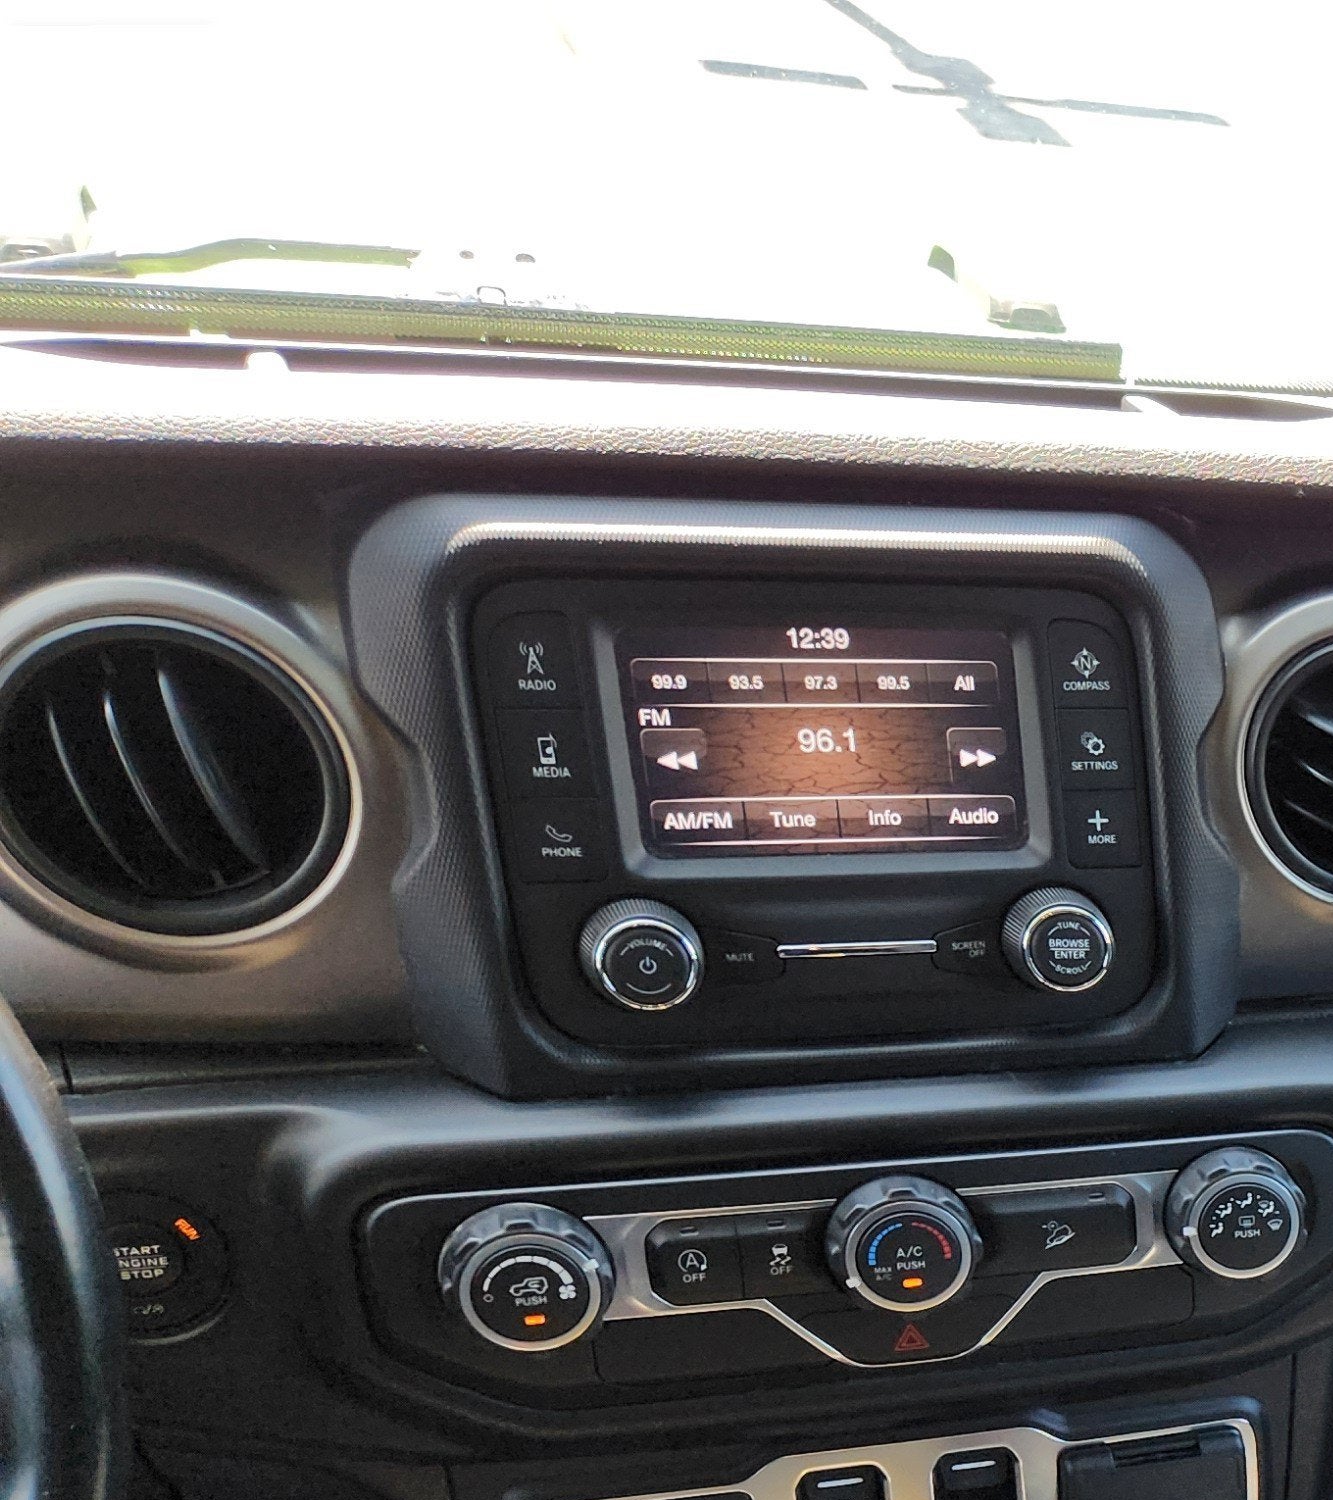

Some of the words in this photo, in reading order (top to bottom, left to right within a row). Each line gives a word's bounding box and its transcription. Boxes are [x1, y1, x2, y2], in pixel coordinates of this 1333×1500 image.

[786, 627, 850, 650] 12:39
[518, 679, 556, 691] RADIO
[651, 674, 688, 690] 99.9
[728, 674, 764, 690] 93.5
[804, 676, 838, 690] 97.3
[877, 676, 910, 690] 99.5
[954, 675, 975, 691] All
[1063, 680, 1111, 692] COMPASS
[638, 708, 672, 727] FM
[797, 728, 857, 753] 96.1
[532, 766, 571, 778] MEDIA
[1071, 760, 1118, 772] SETTINGS
[663, 811, 733, 830] AM/FM
[770, 809, 816, 828] Tune
[868, 809, 901, 827] Info
[949, 808, 999, 825] Audio
[1088, 834, 1117, 845] MORE
[541, 847, 583, 858] PHONE
[1057, 921, 1081, 931] TUNE
[627, 938, 668, 950] VOLUME
[952, 940, 986, 951] SCREEN
[1049, 938, 1090, 949] BROWSE
[725, 952, 755, 963] MUTE
[968, 949, 985, 959] OFF
[1054, 950, 1086, 960] ENTER
[1055, 963, 1089, 975] SCROLL
[1234, 1229, 1261, 1239] PUSH
[896, 1246, 923, 1258] A/C
[118, 1256, 169, 1269] NGINE
[897, 1260, 926, 1271] PUSH
[120, 1268, 164, 1281] STOP
[770, 1265, 793, 1276] OFF
[682, 1272, 706, 1283] OFF
[515, 1295, 547, 1307] PUSH
